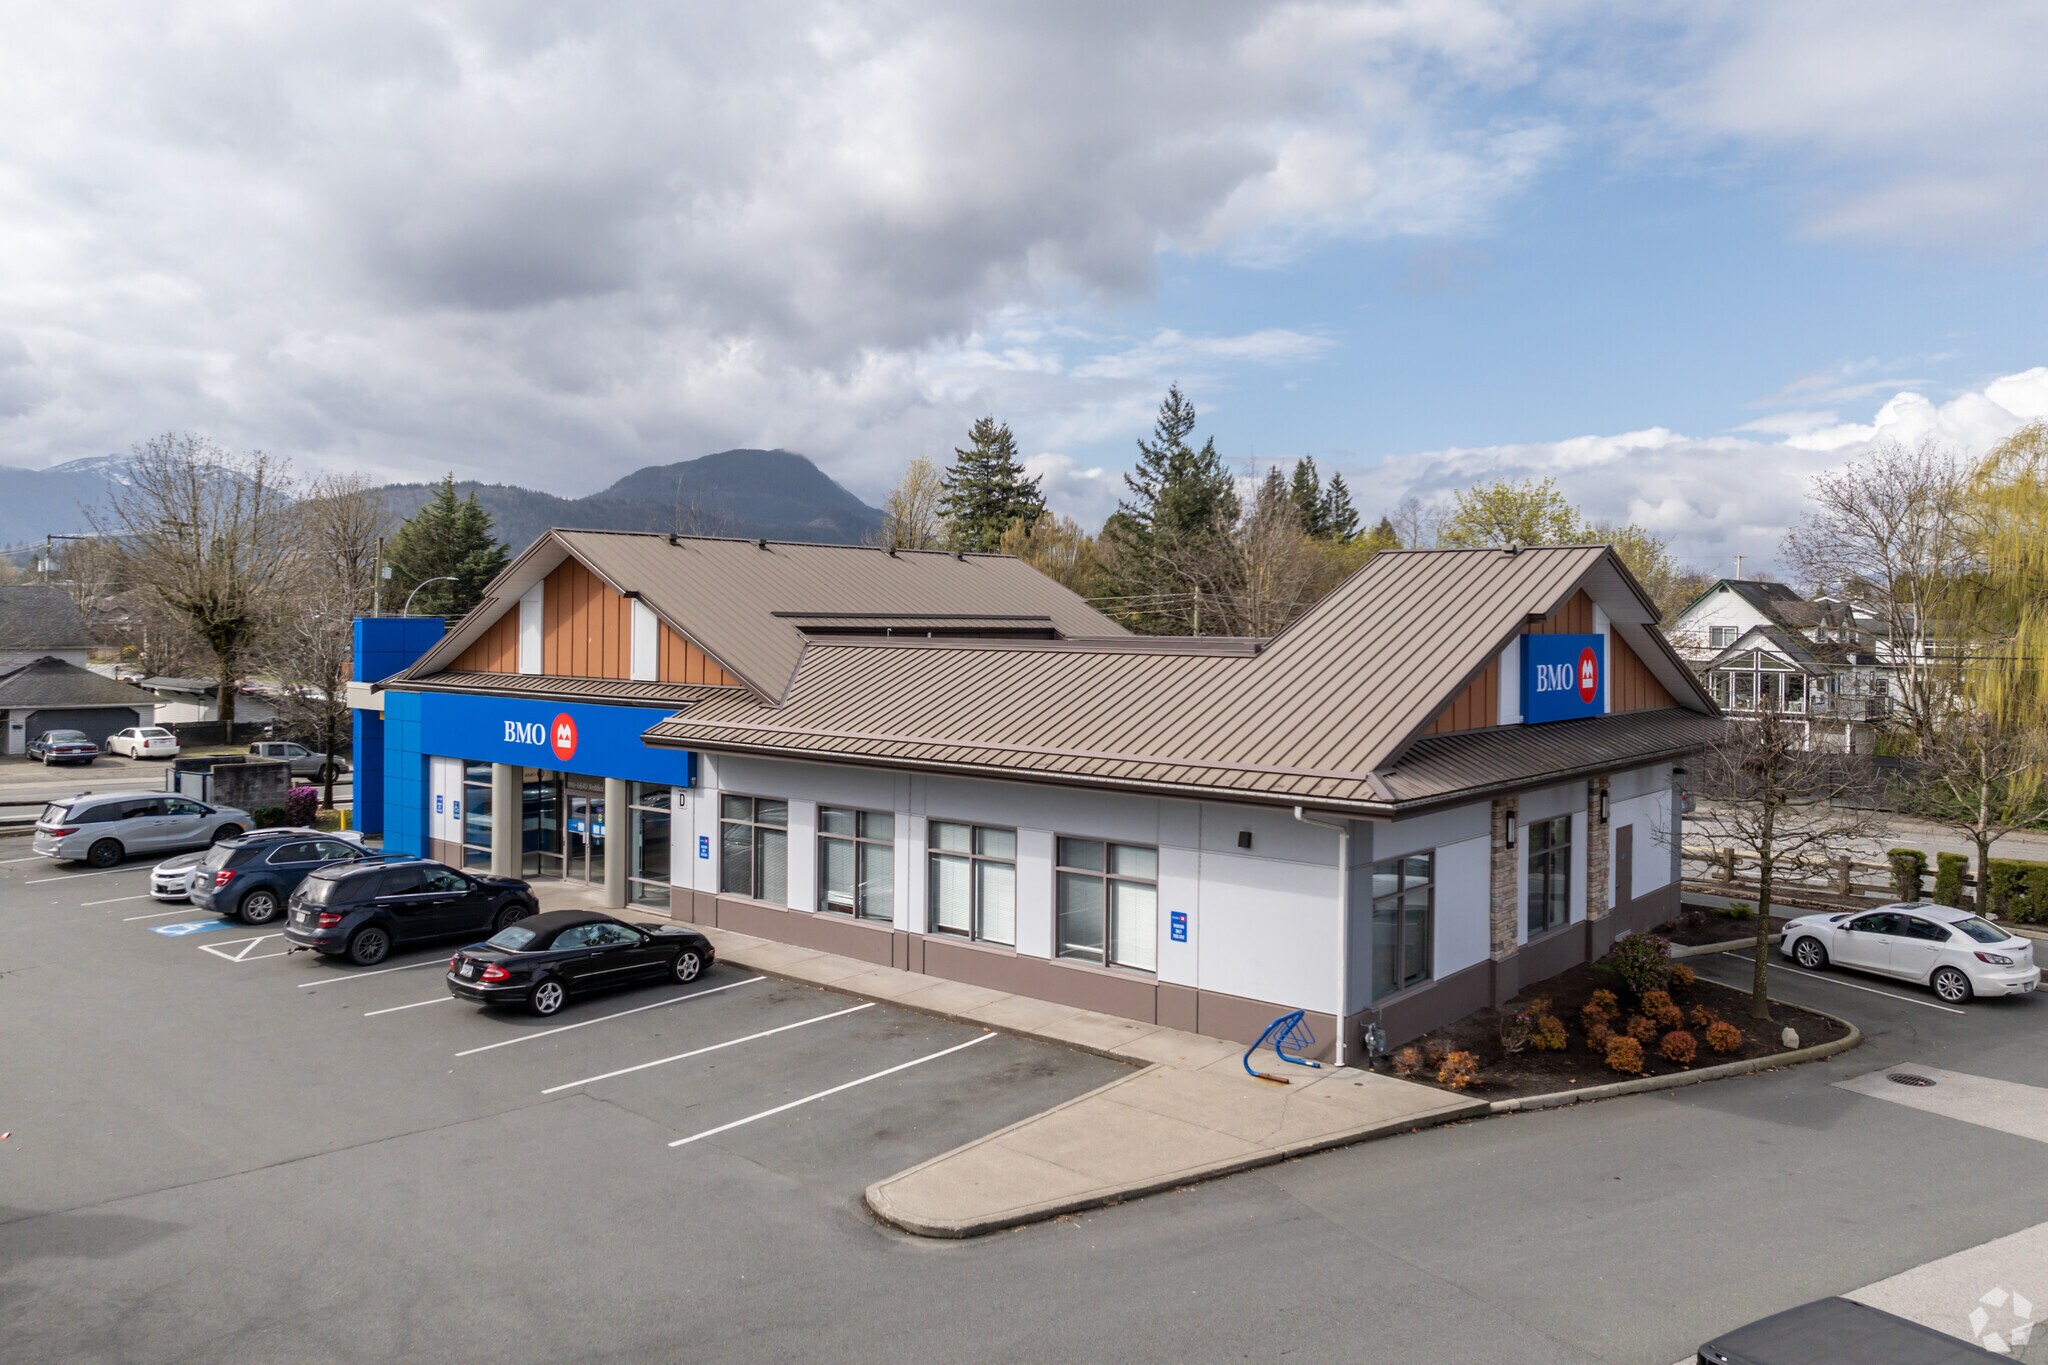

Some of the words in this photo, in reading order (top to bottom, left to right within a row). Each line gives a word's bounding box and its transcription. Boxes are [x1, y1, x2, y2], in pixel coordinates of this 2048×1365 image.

[1536, 663, 1574, 692] BMO
[504, 720, 546, 746] BMO
[680, 794, 685, 806] D
